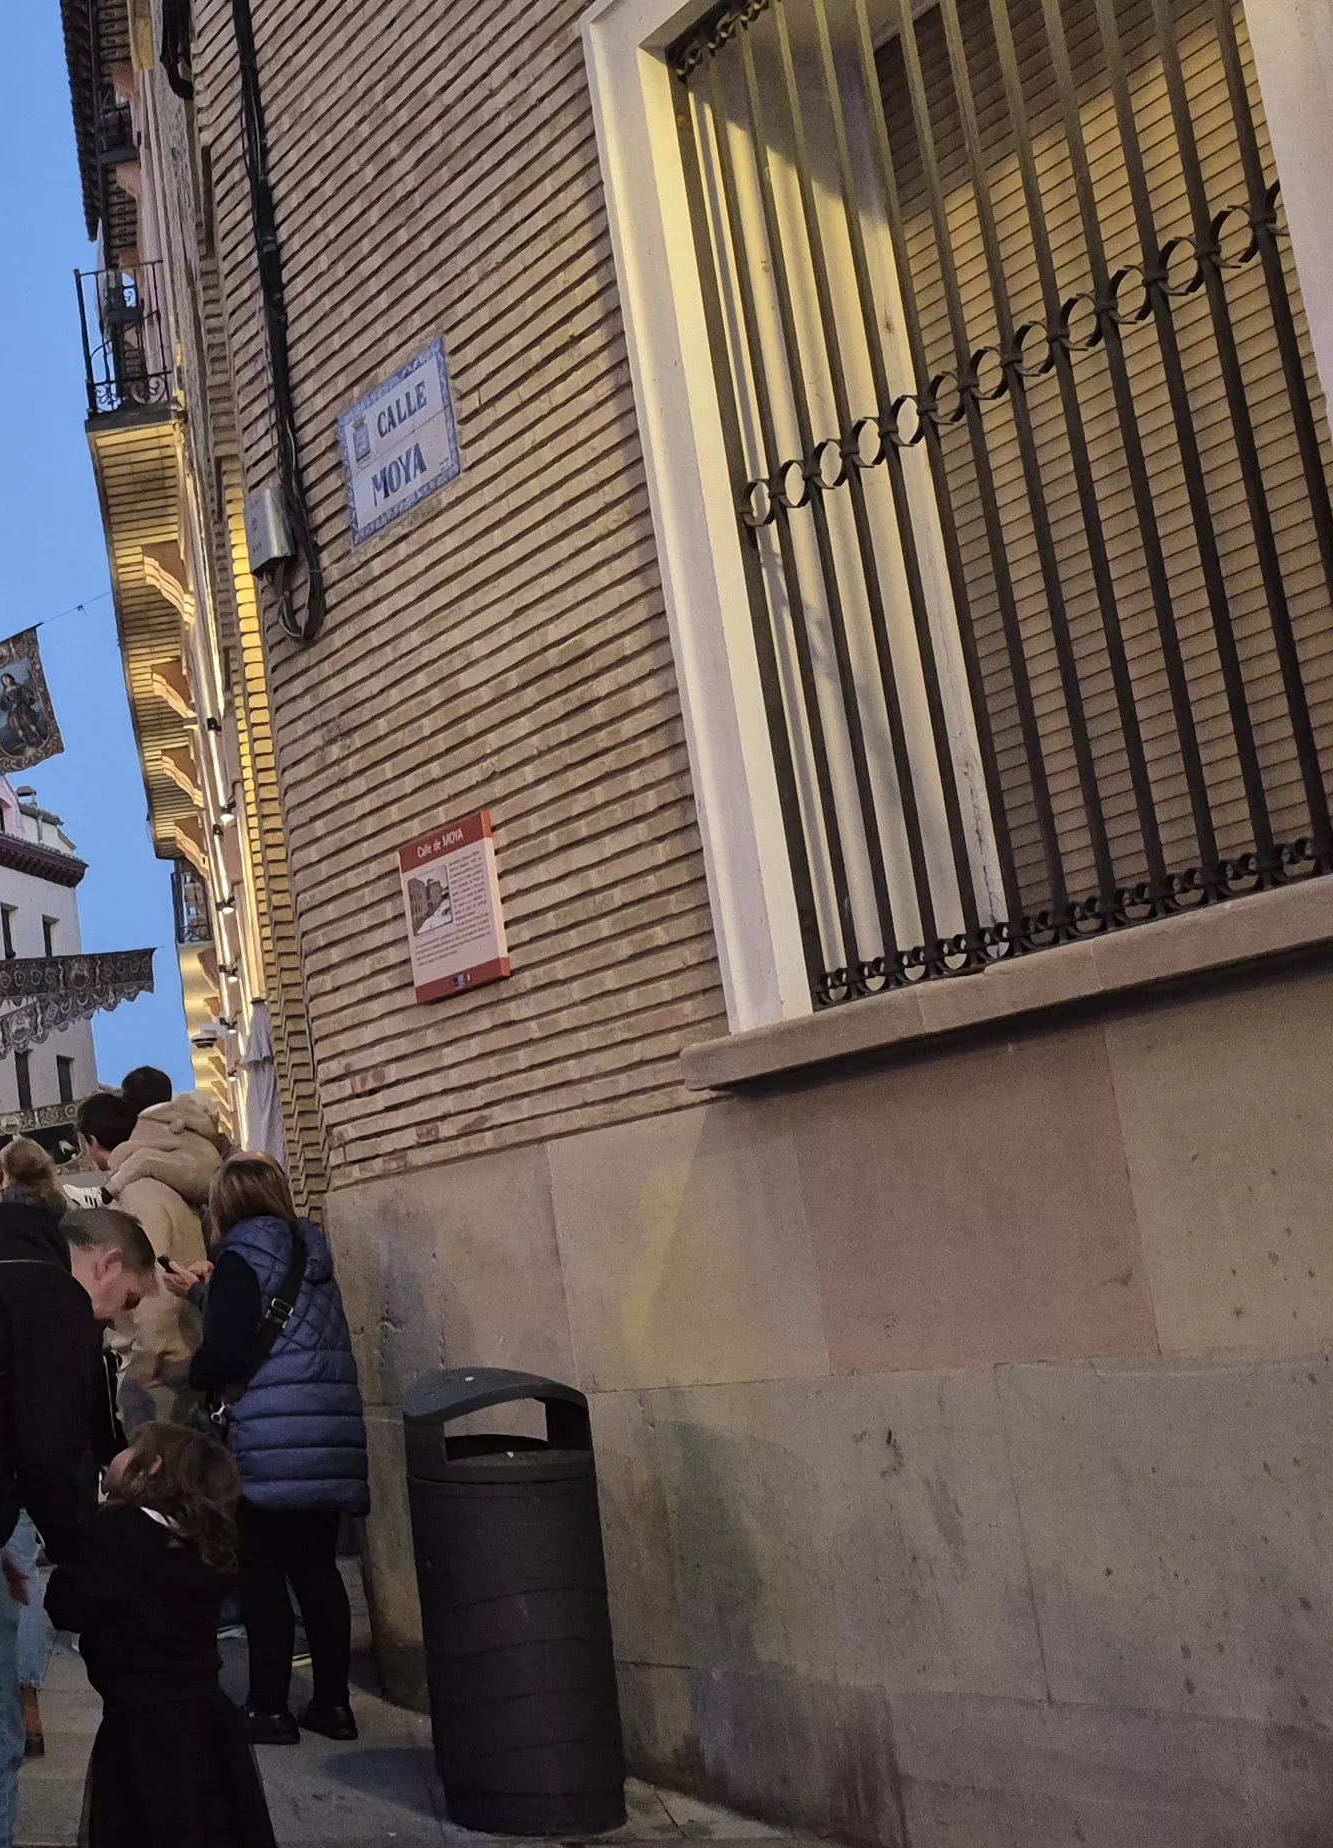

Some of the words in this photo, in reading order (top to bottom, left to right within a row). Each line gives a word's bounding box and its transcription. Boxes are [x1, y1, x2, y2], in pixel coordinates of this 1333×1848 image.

[377, 380, 427, 438] CALLE
[371, 443, 427, 507] MOYA
[433, 839, 442, 851] de
[442, 828, 463, 847] MOYA
